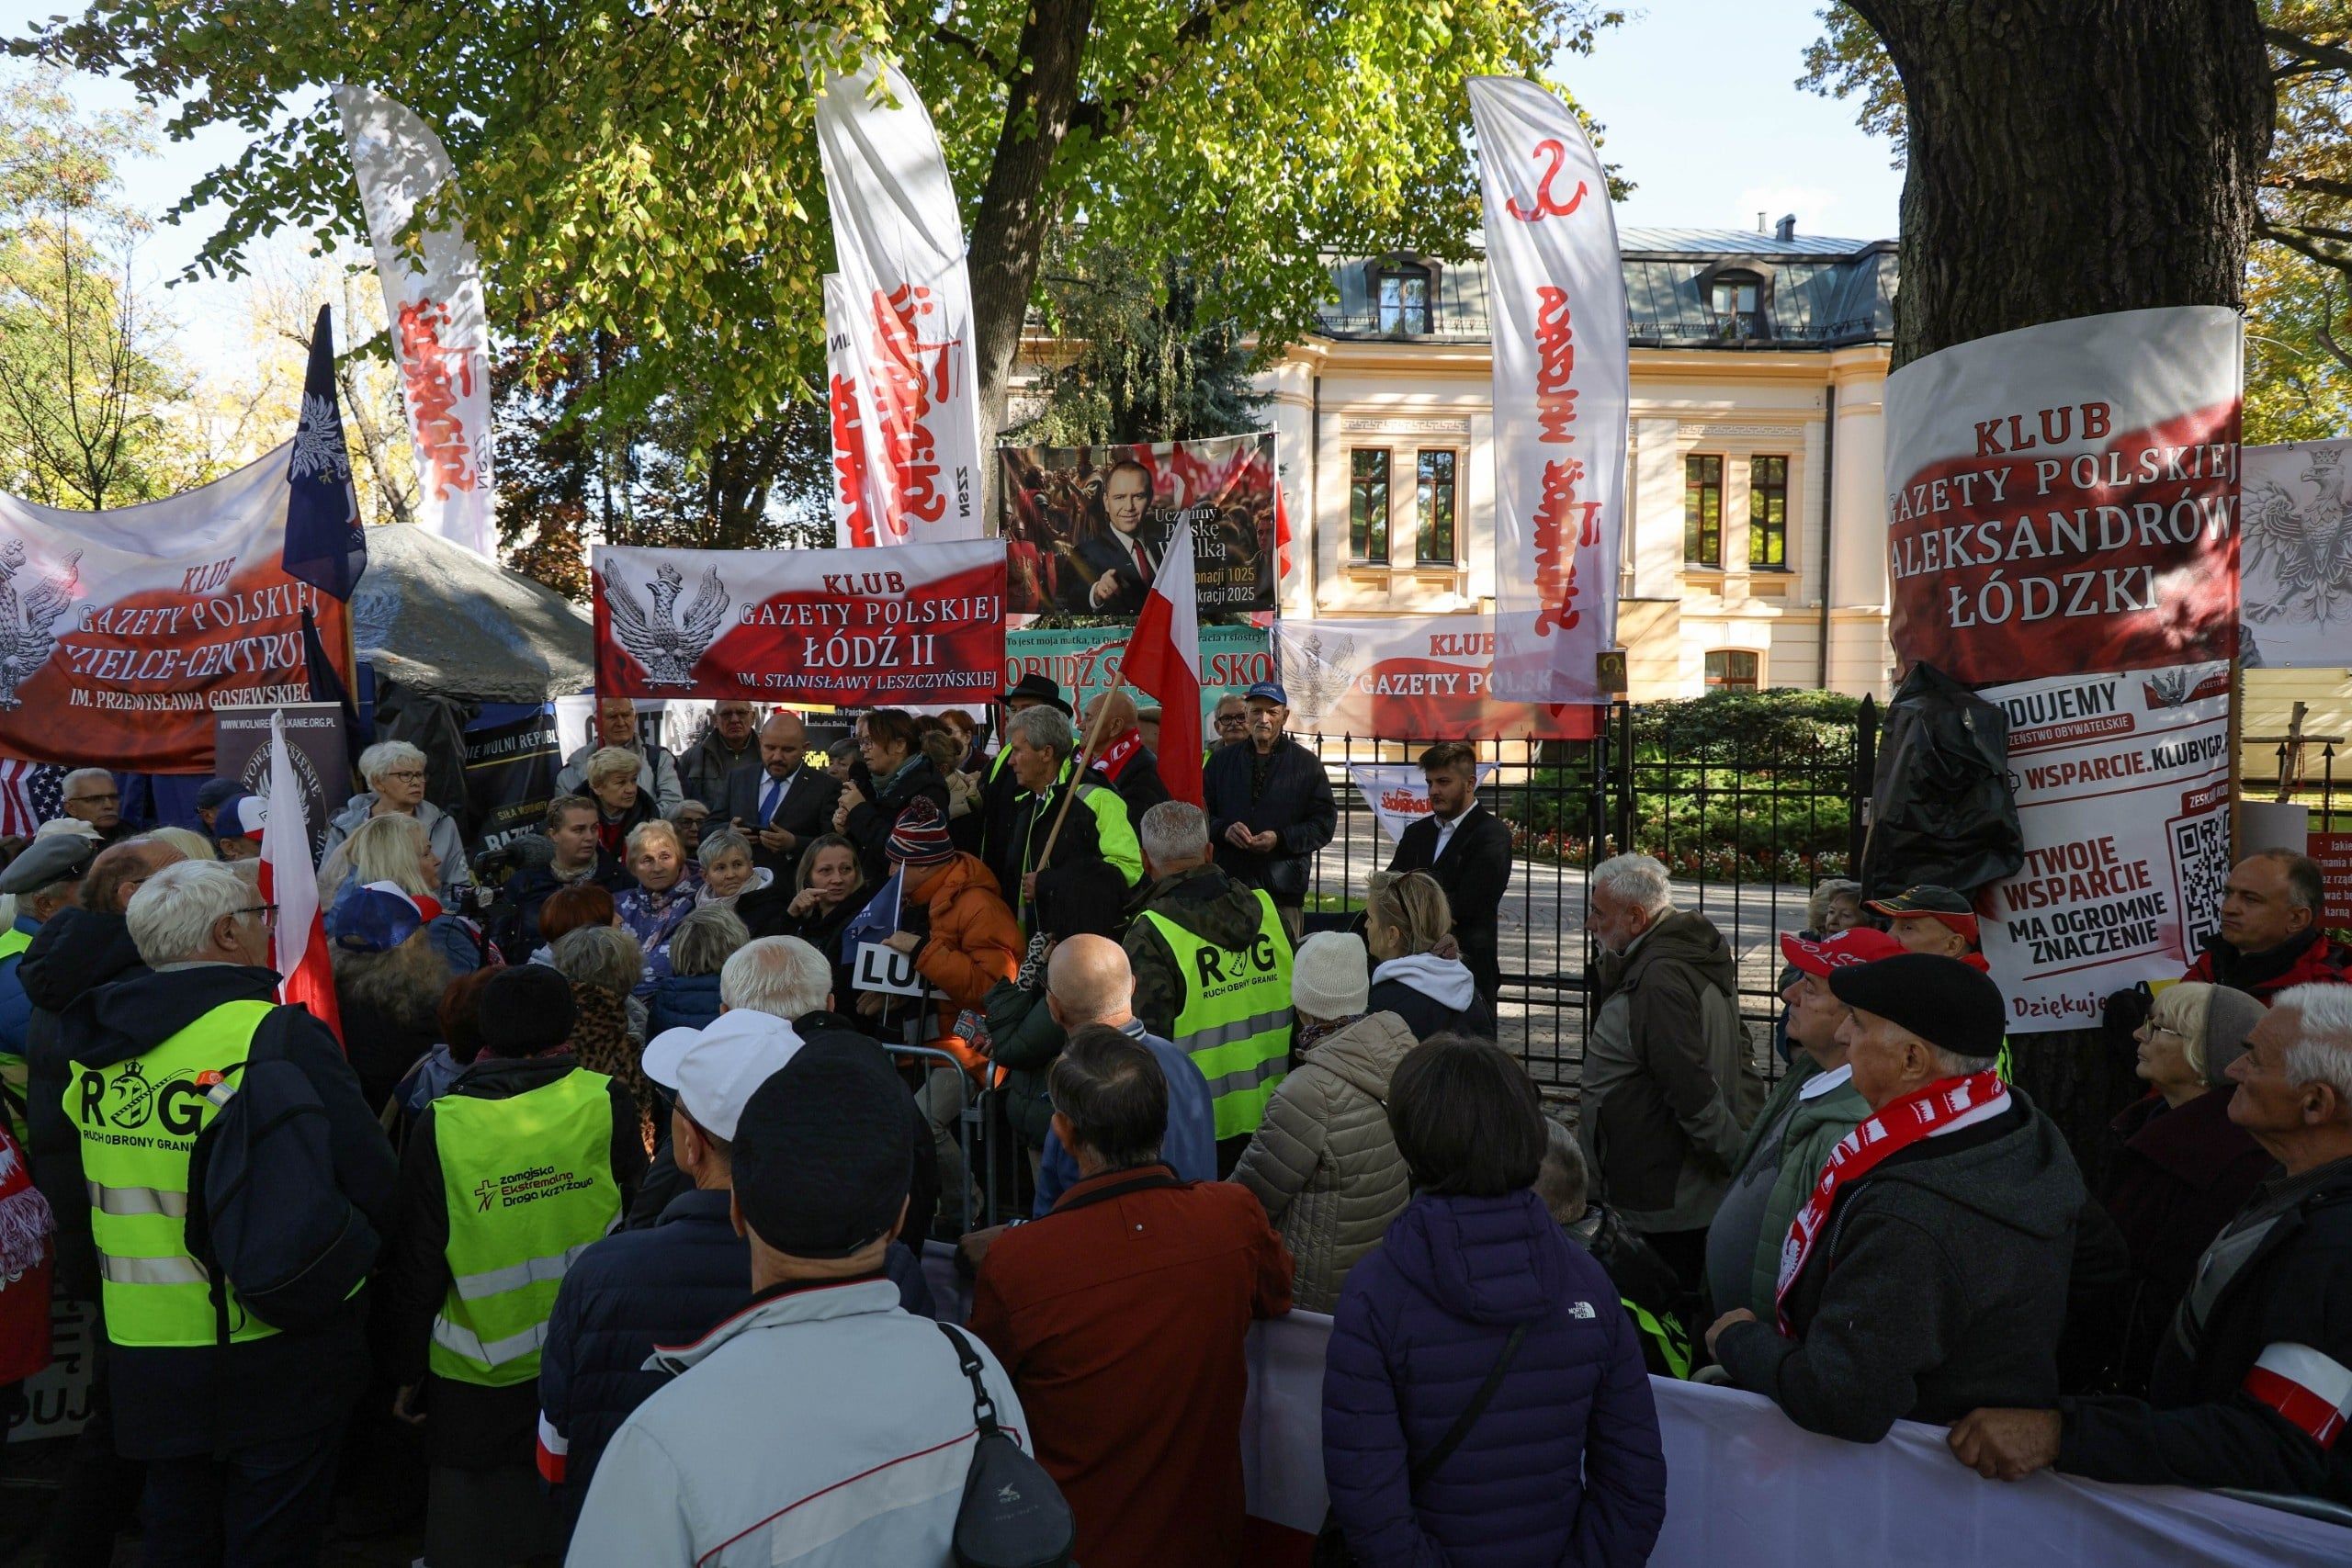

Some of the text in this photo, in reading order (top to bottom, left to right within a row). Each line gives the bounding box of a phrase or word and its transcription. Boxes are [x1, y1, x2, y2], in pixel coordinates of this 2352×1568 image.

[1974, 401, 2110, 457] KLUB
[1888, 442, 2240, 525] GAZETY POLSKIEJ
[1891, 486, 2238, 581] ALEKSANDRÓW
[178, 557, 236, 595] KLUB
[822, 570, 905, 597] KLUB
[1194, 567, 1255, 585] onacji 1025
[739, 595, 1000, 626] GAZETY POLSKIEJ
[1197, 586, 1255, 605] kracji 2025
[1948, 564, 2159, 630] ŁÓDZKI
[77, 604, 186, 636] GAZETY
[802, 626, 934, 669] ŁÓDŹ II
[1006, 637, 1017, 646] To
[1018, 637, 1035, 647] jest
[1036, 637, 1057, 647] moja
[1060, 636, 1090, 646] matka,
[1091, 636, 1101, 645] ta
[1198, 633, 1221, 642] racia
[1429, 633, 1496, 657] KLUB
[736, 668, 998, 691] IM. STANISŁAWY LESZCZYŃSKIEJ
[1199, 651, 1274, 687] LSKO
[1359, 672, 1457, 695] GAZETY
[69, 682, 311, 711] IM. PRZEMYSŁAWA GOSIEWSKIEG
[1995, 682, 2116, 728] DUJEMY
[483, 736, 516, 756] WOLNI
[519, 728, 559, 749] REPUBL
[2007, 716, 2130, 746] ZEŃSTWO OBYWATELSKIE
[2024, 835, 2120, 878] TWOJE
[2003, 860, 2154, 912] WSPARCIE
[2007, 891, 2168, 943] MA OGROMNE
[2029, 919, 2159, 964] ZNACZENIE
[862, 950, 919, 988] LU
[1203, 987, 1226, 999] RUCH
[84, 1130, 195, 1152] RUCH OBRONY GRAN
[502, 1172, 573, 1196] Ekstremalna
